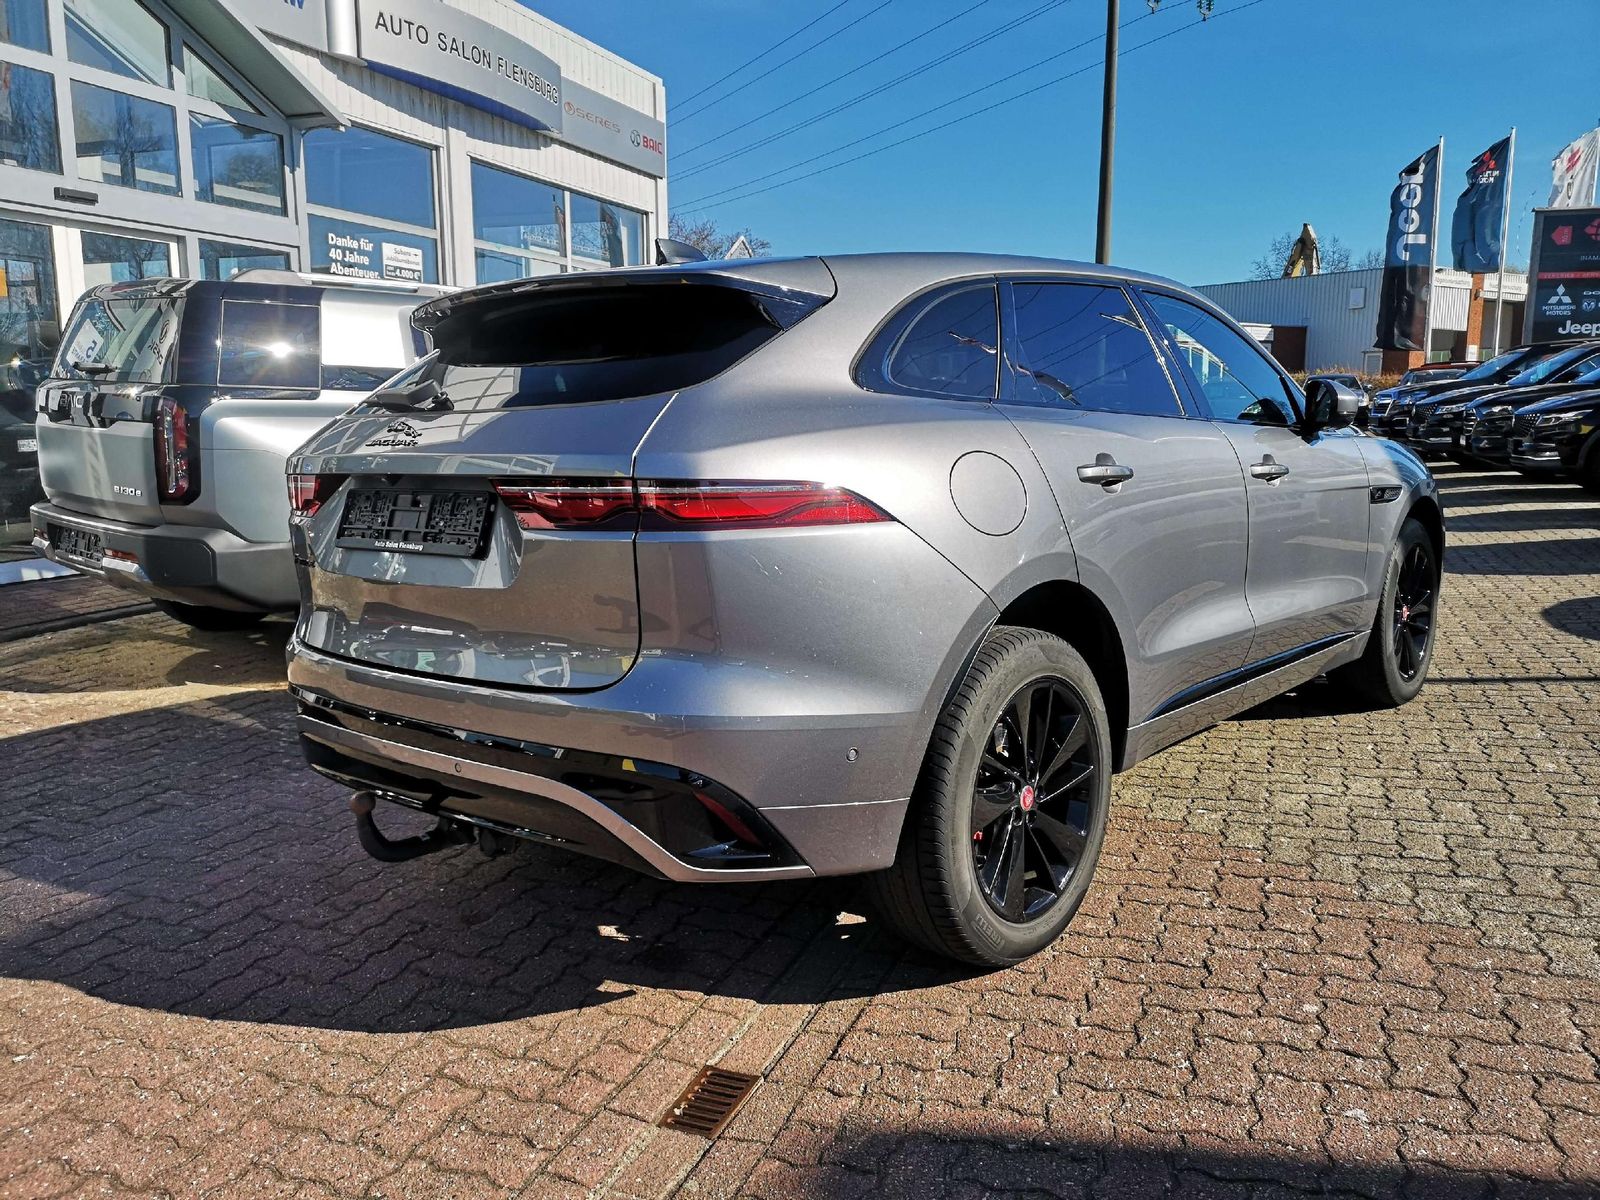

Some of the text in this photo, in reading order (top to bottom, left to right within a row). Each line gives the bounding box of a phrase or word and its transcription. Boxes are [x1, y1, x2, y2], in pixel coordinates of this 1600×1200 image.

[374, 11, 559, 105] AUTO SALON FLENSBURG
[575, 107, 621, 134] SERES
[642, 135, 663, 155] BAIC
[328, 232, 374, 252] Danke für
[329, 247, 342, 261] 40
[343, 250, 369, 265] Jahre
[330, 262, 381, 280] Abenteuer.
[395, 268, 414, 279] 4.000
